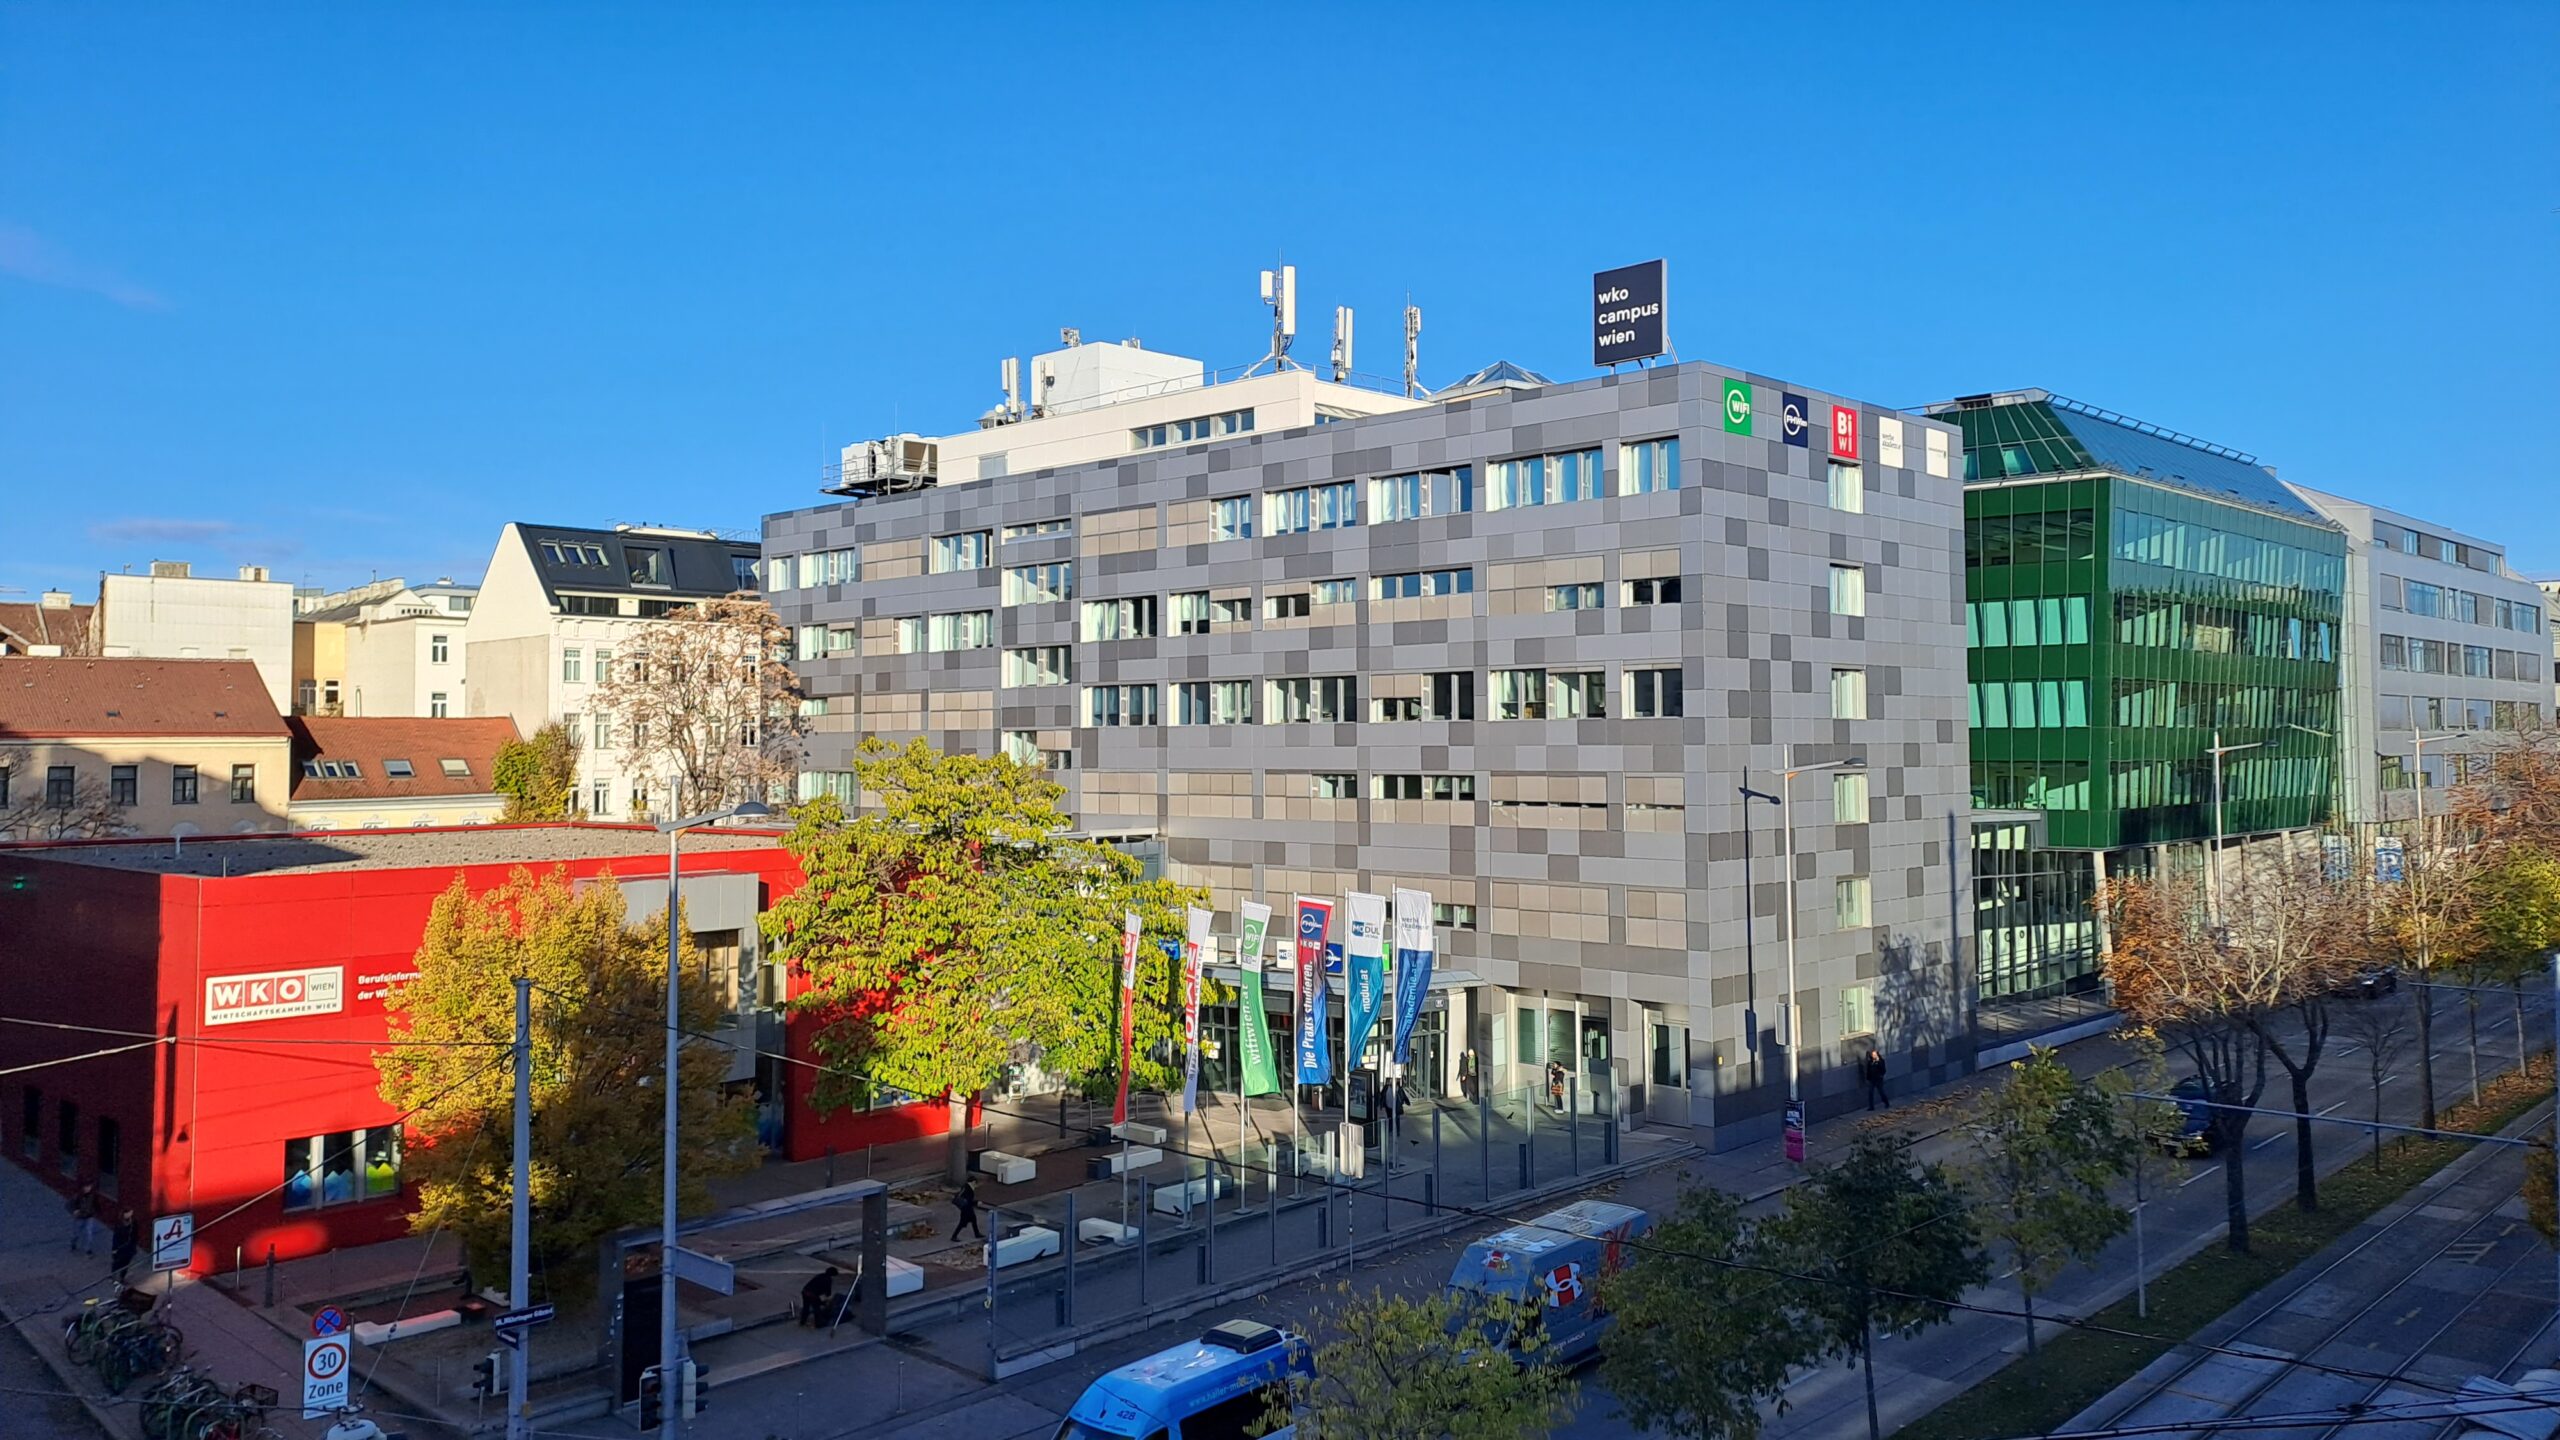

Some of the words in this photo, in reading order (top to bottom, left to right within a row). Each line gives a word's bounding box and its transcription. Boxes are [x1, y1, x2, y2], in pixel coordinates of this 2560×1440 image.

[1598, 286, 1629, 304] wko
[1598, 303, 1659, 324] campus
[1598, 329, 1636, 347] wien
[1731, 400, 1750, 415] WIFI
[1838, 411, 1853, 437] Bi
[213, 978, 303, 1008] WKO
[311, 983, 335, 992] WIEN
[357, 990, 375, 1001] der
[1304, 960, 1314, 1013] studieren.
[1359, 969, 1370, 1013] modul.at
[211, 1005, 312, 1021] WIRTSCHAFTSKAMMER
[1243, 983, 1261, 1064] wifiwien.at
[1302, 1016, 1315, 1049] Praxis
[1304, 1051, 1318, 1069] Die
[318, 1352, 337, 1371] 30
[309, 1381, 344, 1400] Zone
[1116, 1411, 1137, 1421] 428
